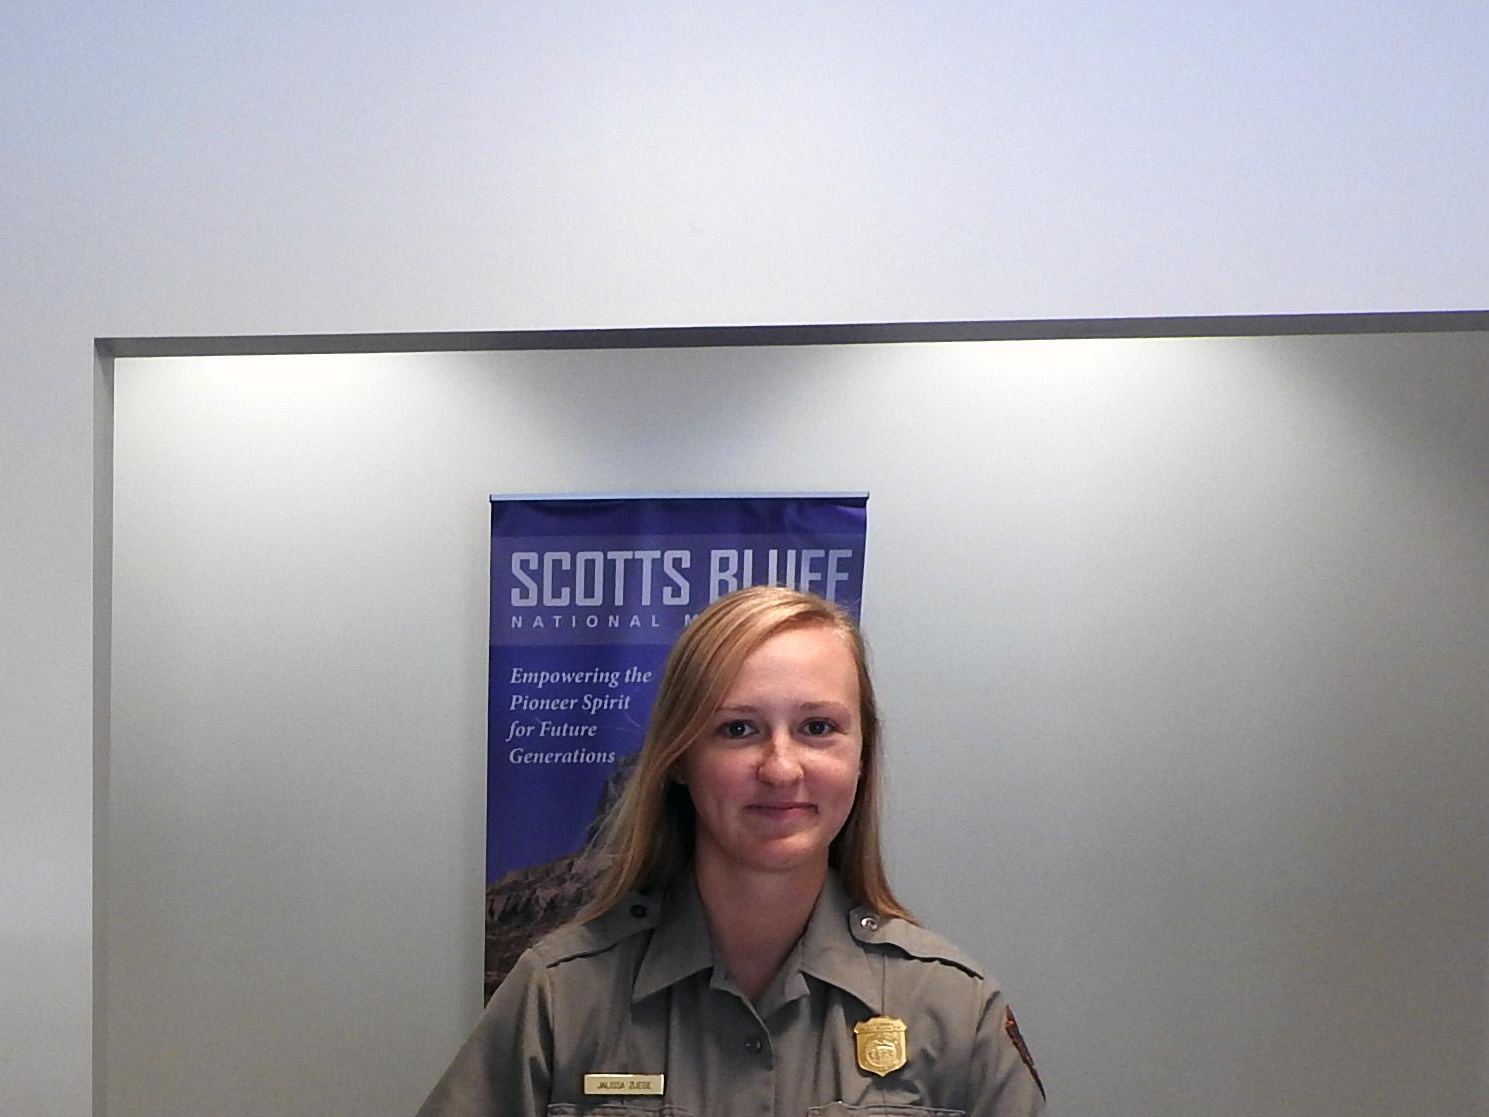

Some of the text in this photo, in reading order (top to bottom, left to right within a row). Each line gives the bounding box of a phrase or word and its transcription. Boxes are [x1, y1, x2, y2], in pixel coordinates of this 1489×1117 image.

[511, 549, 691, 607] SCOTTS
[512, 614, 660, 628] NATIONAL
[511, 667, 652, 688] Empowering the
[510, 693, 630, 714] Pioneer Spirit
[506, 720, 597, 742] for Future
[510, 748, 616, 765] Generations
